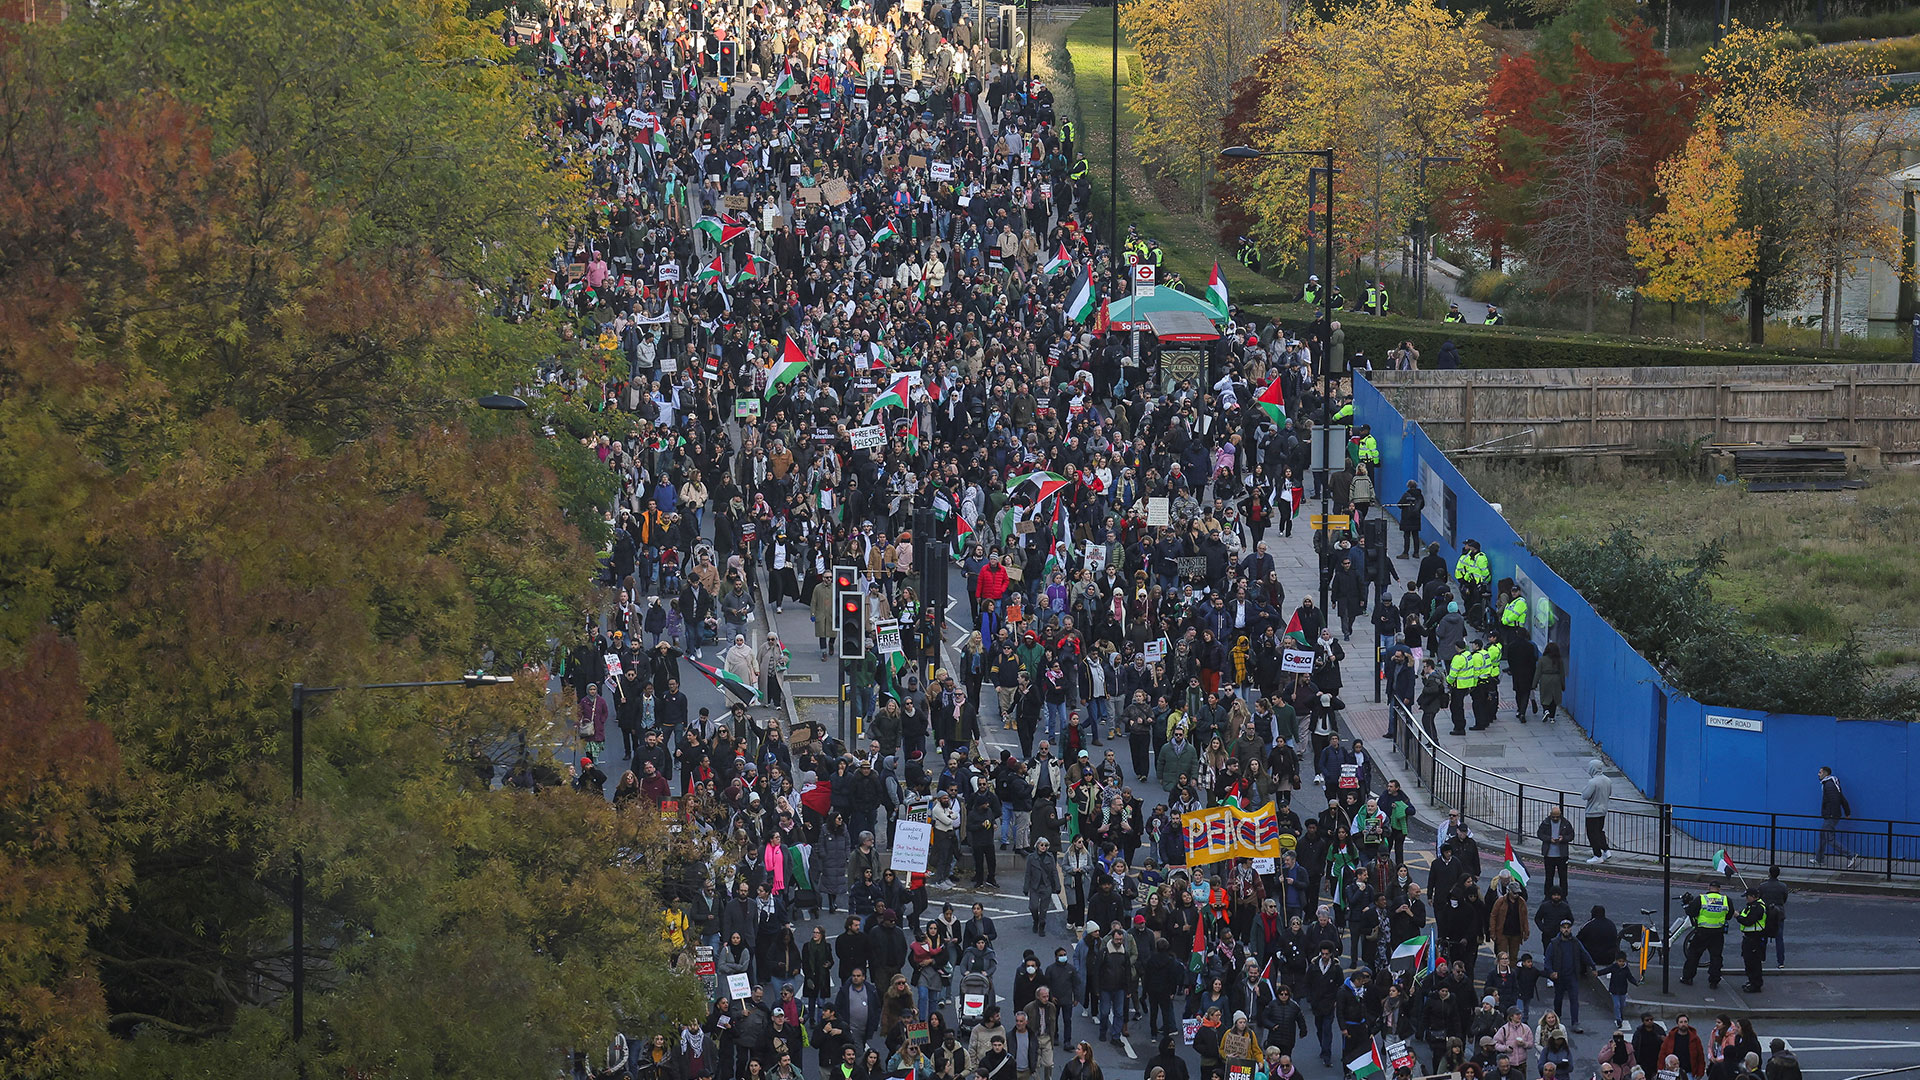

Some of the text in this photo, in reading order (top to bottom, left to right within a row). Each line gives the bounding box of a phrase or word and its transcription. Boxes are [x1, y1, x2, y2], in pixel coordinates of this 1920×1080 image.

[1130, 255, 1137, 264] D
[855, 430, 869, 439] FREE
[854, 436, 886, 448] PALESTINE
[878, 632, 899, 644] FREE
[1285, 653, 1312, 665] Gaza
[1735, 720, 1751, 728] ROAD
[907, 812, 927, 821] FREE
[1189, 811, 1272, 859] PEACE
[1242, 1066, 1252, 1075] THE
[1229, 1072, 1251, 1080] SIEGE
